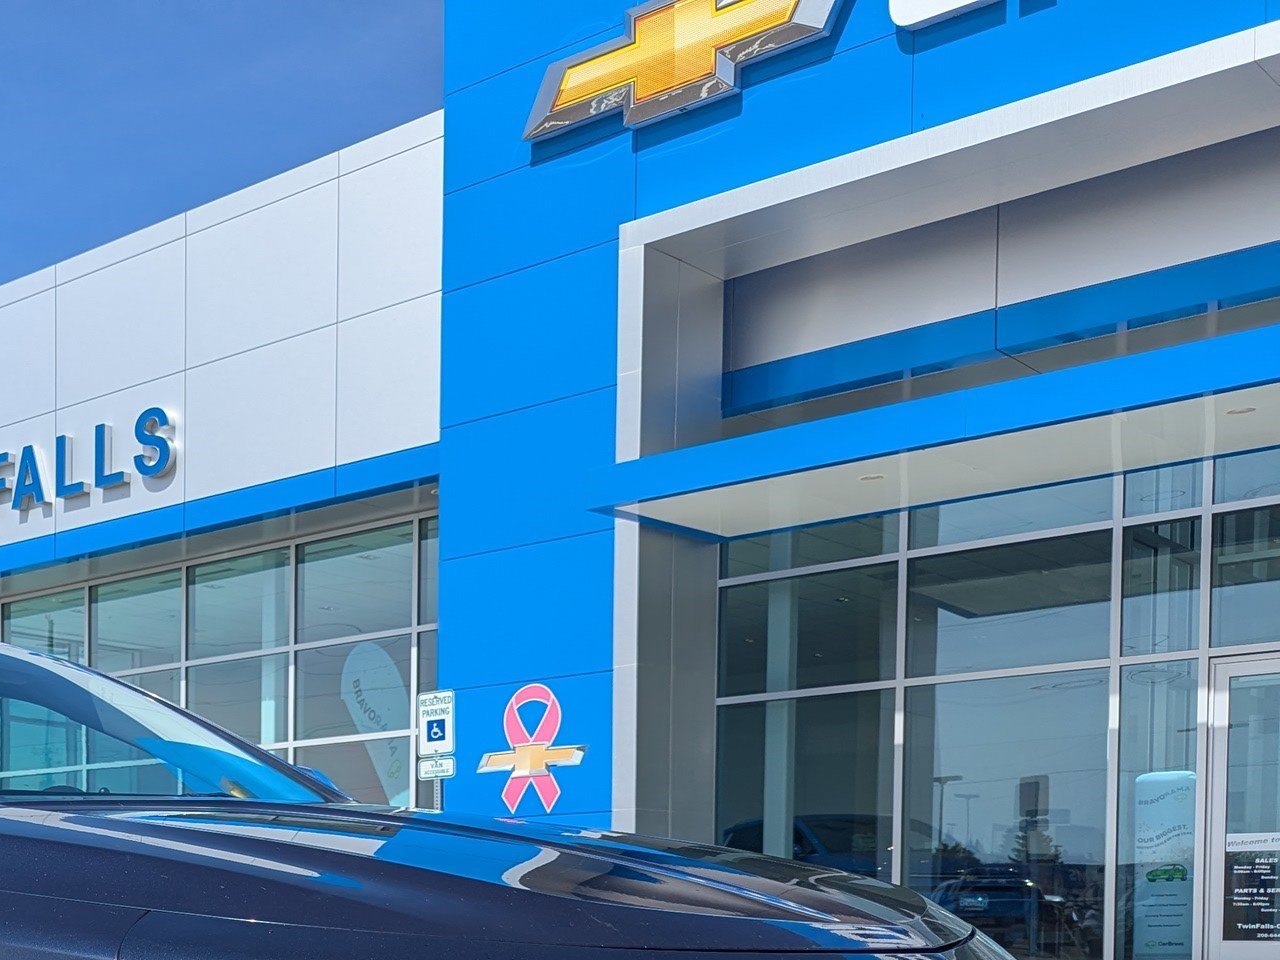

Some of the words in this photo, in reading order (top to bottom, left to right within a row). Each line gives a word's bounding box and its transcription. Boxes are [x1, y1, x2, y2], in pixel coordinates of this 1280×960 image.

[420, 696, 452, 706] RESERVED
[422, 707, 450, 718] PARKING
[1227, 838, 1268, 848] Welcome
